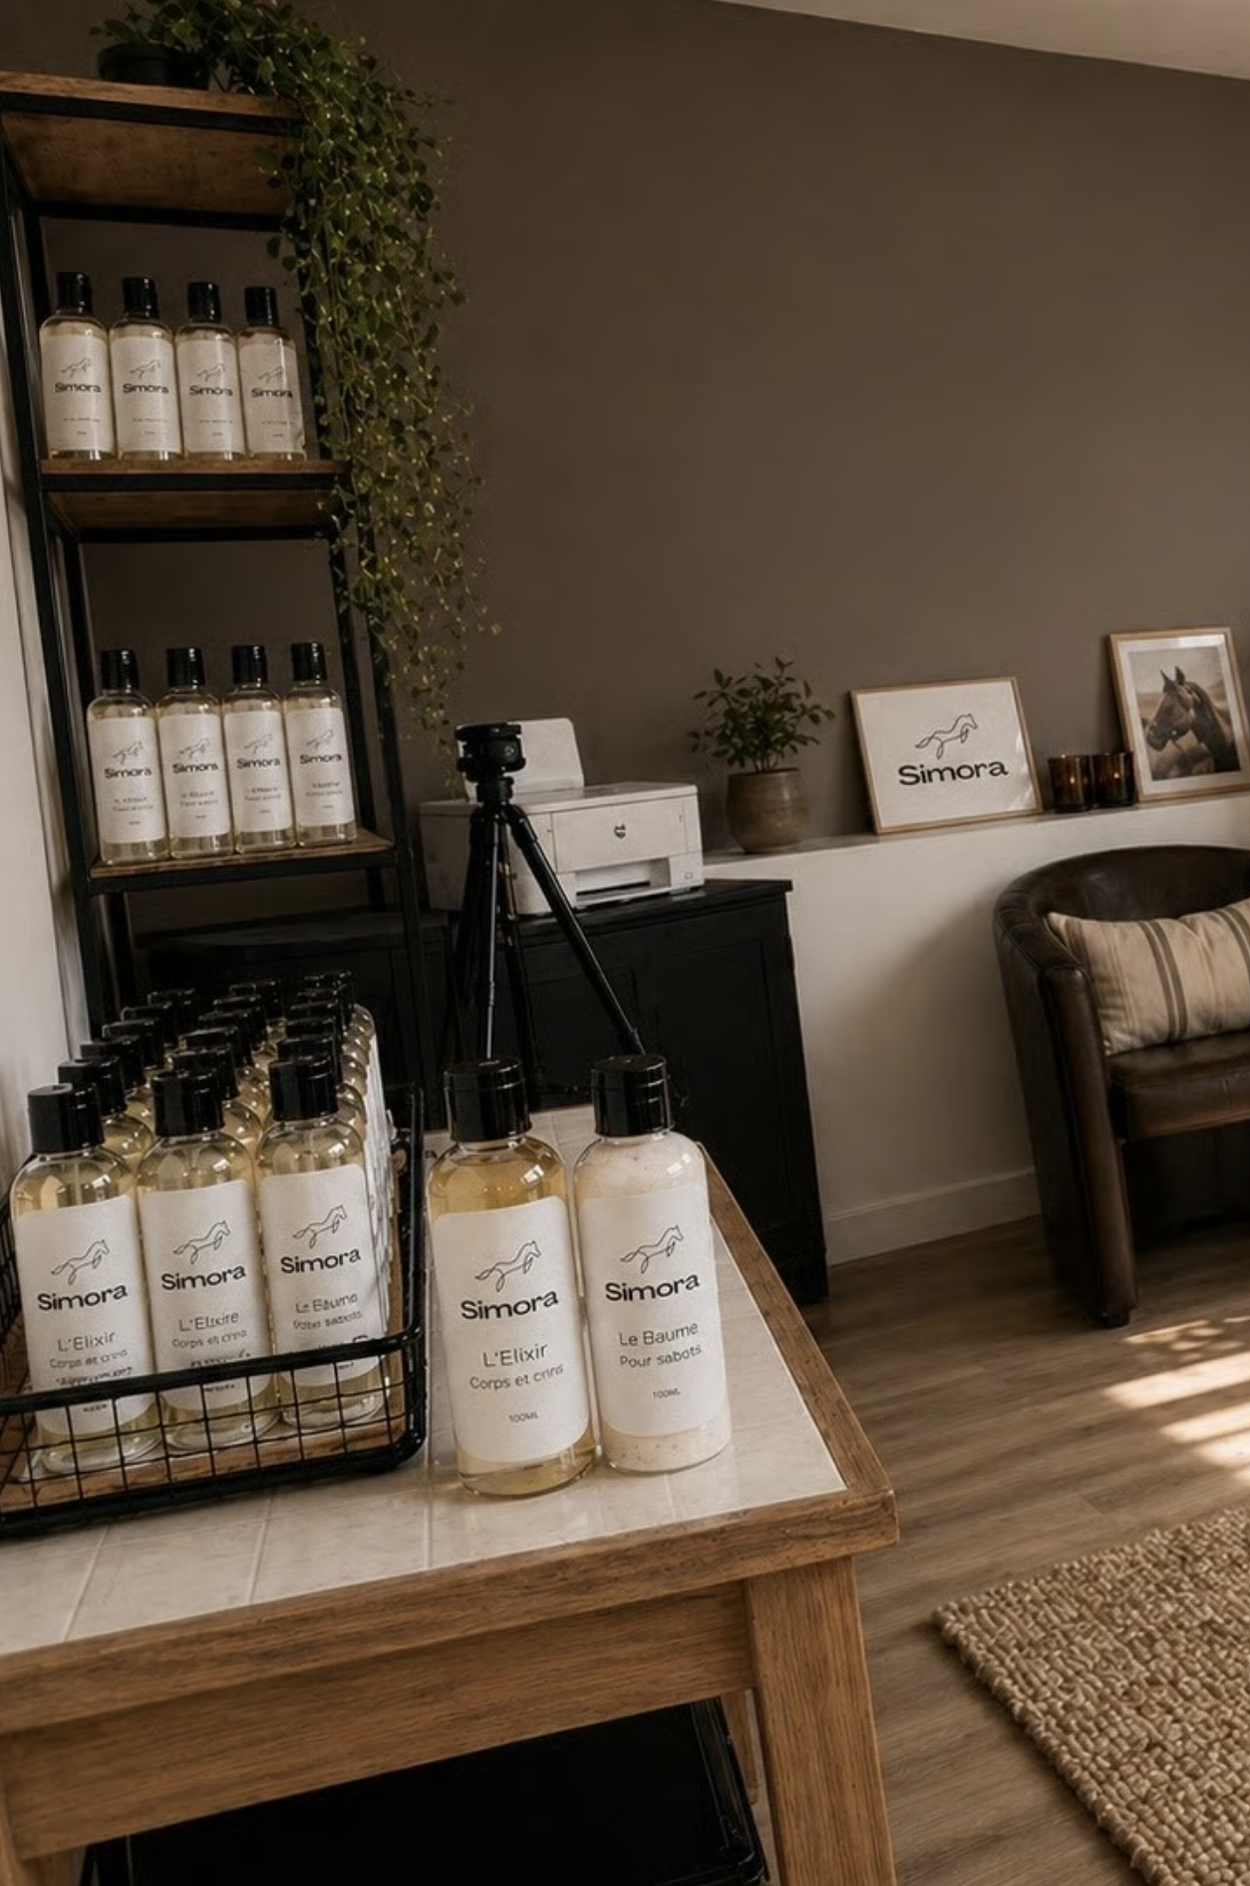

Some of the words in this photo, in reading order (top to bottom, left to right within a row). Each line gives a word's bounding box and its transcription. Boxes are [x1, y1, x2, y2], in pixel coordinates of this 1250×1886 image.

[898, 762, 1008, 785] Simora
[281, 1247, 361, 1273] Simora
[161, 1263, 246, 1290] Simora
[606, 1275, 699, 1301] Simora
[38, 1283, 127, 1310] Simora
[461, 1290, 558, 1319] Simora
[619, 1333, 638, 1346] Le
[643, 1323, 700, 1346] Baume
[483, 1344, 547, 1367] L'Elixir
[620, 1355, 651, 1368] Pour
[657, 1345, 701, 1365] sabots
[470, 1377, 511, 1391] Corps
[515, 1374, 529, 1386] et
